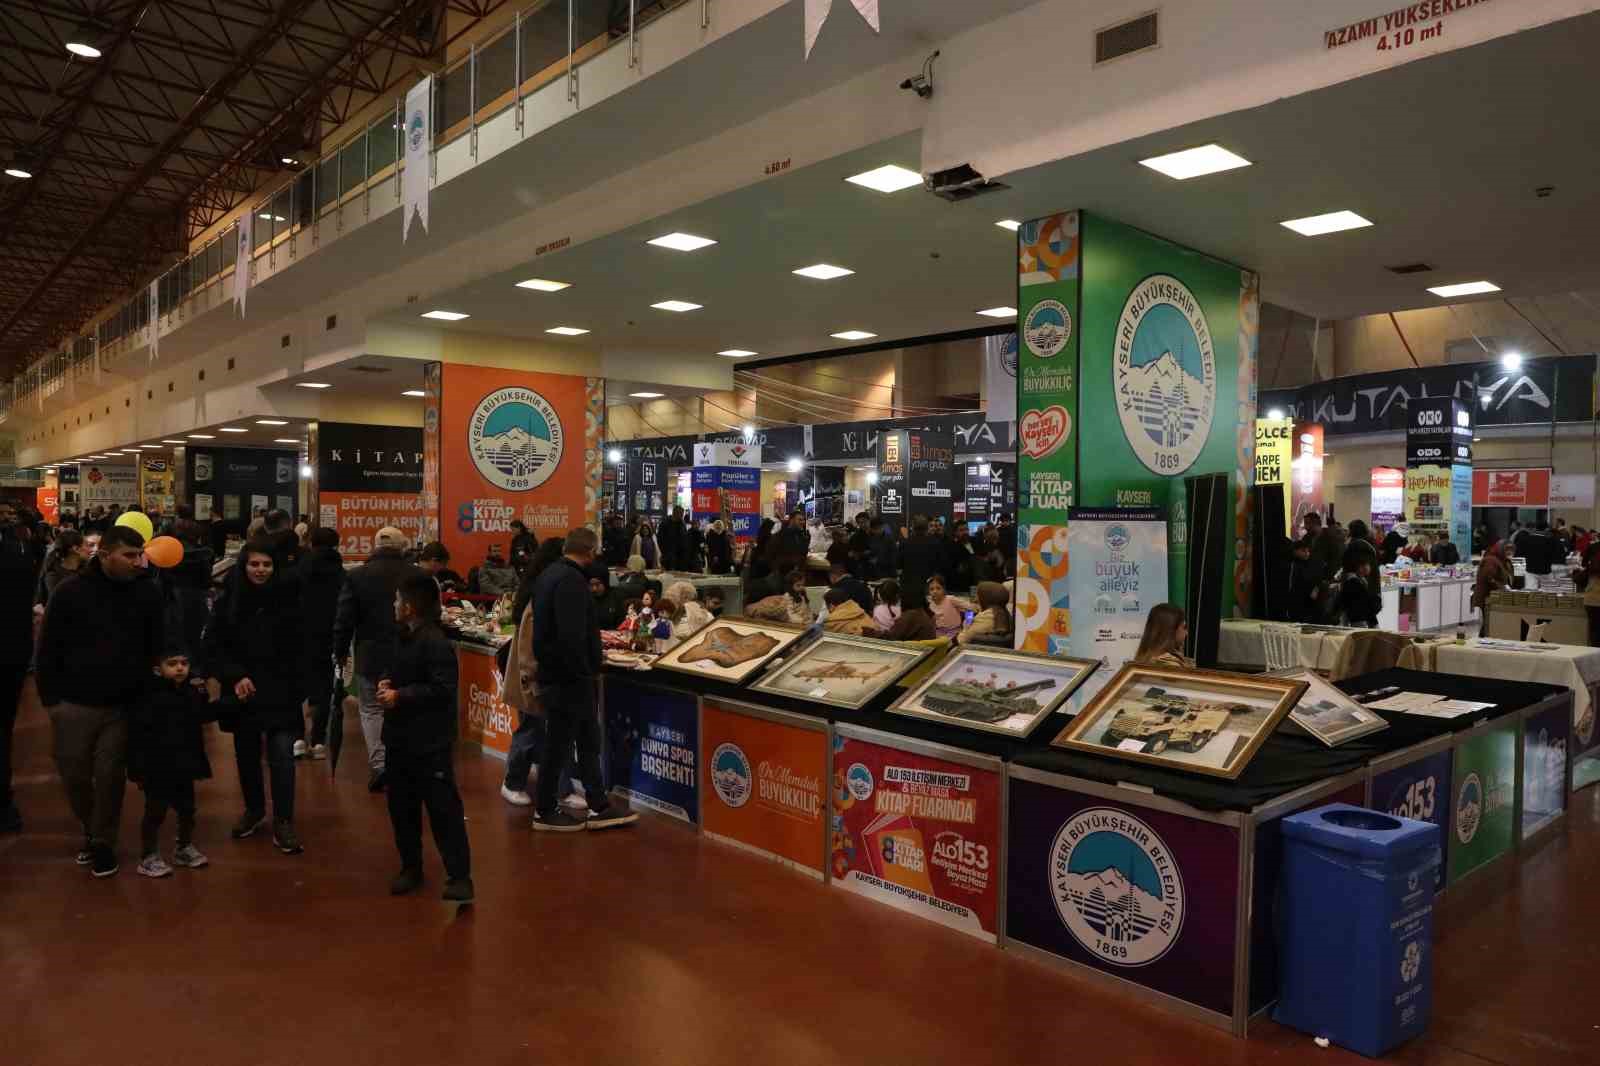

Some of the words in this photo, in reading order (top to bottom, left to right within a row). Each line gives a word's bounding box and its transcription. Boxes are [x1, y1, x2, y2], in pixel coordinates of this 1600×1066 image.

[1377, 29, 1414, 50] 4.10
[1420, 20, 1442, 41] mt
[1130, 283, 1195, 319] BÜYÜKŞEHİR
[1025, 424, 1059, 440] Kayseri
[840, 432, 857, 452] NG
[1154, 452, 1180, 469] 1869
[1256, 454, 1280, 465] ARPE
[504, 479, 529, 488] 1869
[341, 496, 390, 511] BÜTÜN
[473, 519, 513, 532] FUAR
[670, 746, 694, 765] SPOR
[641, 753, 694, 788] BAŞKENTİ
[900, 770, 911, 781] 153
[878, 789, 911, 813] KİTAP
[1056, 838, 1072, 903] KAYSERİ
[1069, 815, 1150, 846] BÜYÜKŞEHİR
[1150, 846, 1178, 937] BELEDİYESİ
[855, 871, 884, 889] KAYSERİ
[883, 883, 928, 903] BÜYÜKŞEHİR
[928, 898, 969, 918] BELEDİYESİ
[1096, 939, 1128, 958] 1869
